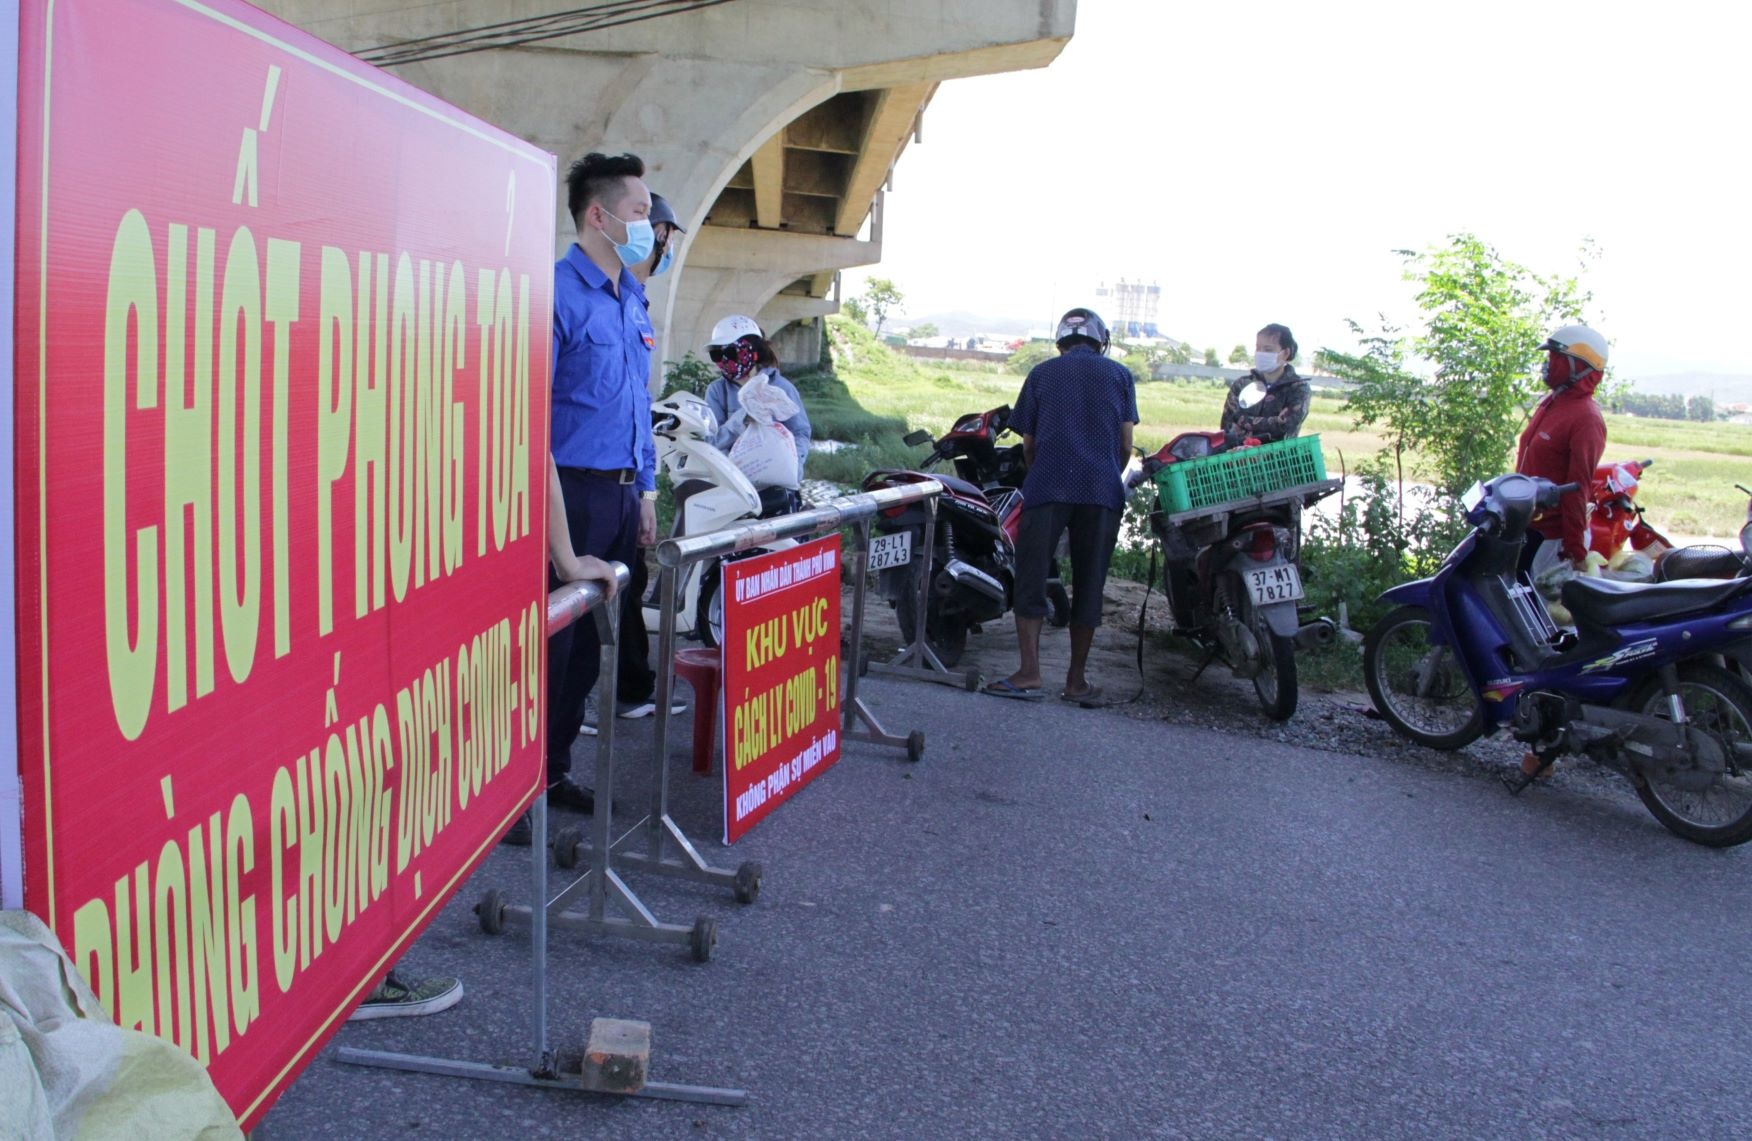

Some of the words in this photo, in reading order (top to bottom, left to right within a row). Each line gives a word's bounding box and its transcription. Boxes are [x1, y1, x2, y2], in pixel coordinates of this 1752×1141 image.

[103, 64, 301, 741] CHỐT
[317, 245, 466, 637] PHONG
[476, 168, 530, 558] TỎA
[870, 548, 907, 569] 287.43
[874, 534, 904, 553] 29-L1
[745, 573, 760, 600] BAN
[1252, 567, 1291, 586] 37-M1
[1256, 582, 1293, 602] 7827
[746, 614, 787, 672] KHU
[792, 596, 828, 655] VỰC
[734, 687, 768, 771] CÁCH
[769, 683, 783, 749] LY
[785, 666, 816, 739] COVID
[824, 654, 837, 712] 19
[270, 651, 394, 993] CHỐNG
[396, 656, 452, 900] DỊCH
[457, 600, 539, 810] COVID-19
[736, 783, 766, 822] KHÔNG
[767, 762, 790, 799] PHẬN
